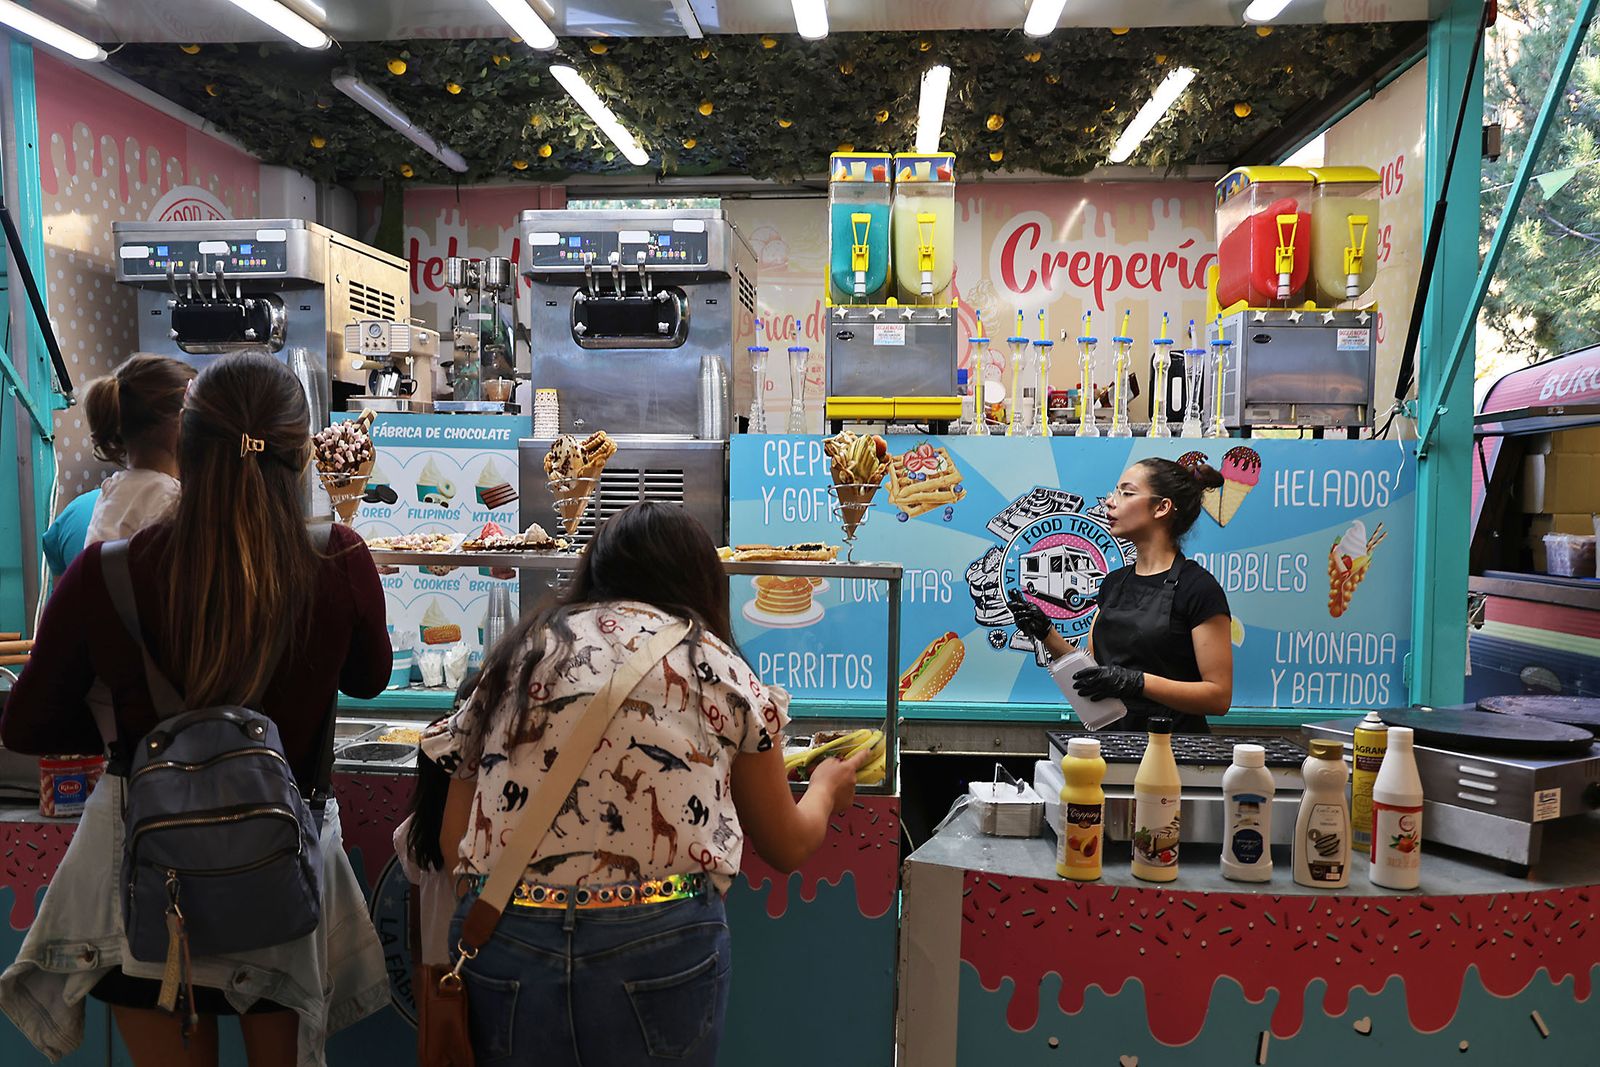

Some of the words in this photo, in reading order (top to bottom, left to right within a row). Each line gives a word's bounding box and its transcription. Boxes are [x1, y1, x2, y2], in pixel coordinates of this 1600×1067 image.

[372, 422, 422, 438] FÁBRICA
[425, 427, 441, 439] DE
[443, 427, 511, 441] CHOCOLATE
[763, 439, 832, 476] CREPE
[761, 486, 776, 525] Y
[1273, 469, 1390, 508] HELADOS
[362, 507, 392, 518] OREO
[407, 508, 461, 520] FILIPINOS
[472, 511, 514, 523] KITKAT
[1022, 518, 1062, 545] FOOD
[1069, 518, 1114, 553] TRUCK
[413, 578, 460, 591] COOKIES
[1005, 568, 1016, 585] LA
[1275, 630, 1396, 665] LIMONADA
[759, 652, 872, 690] PERRITOS
[1270, 668, 1286, 707] Y
[1292, 671, 1390, 706] BATIDOS
